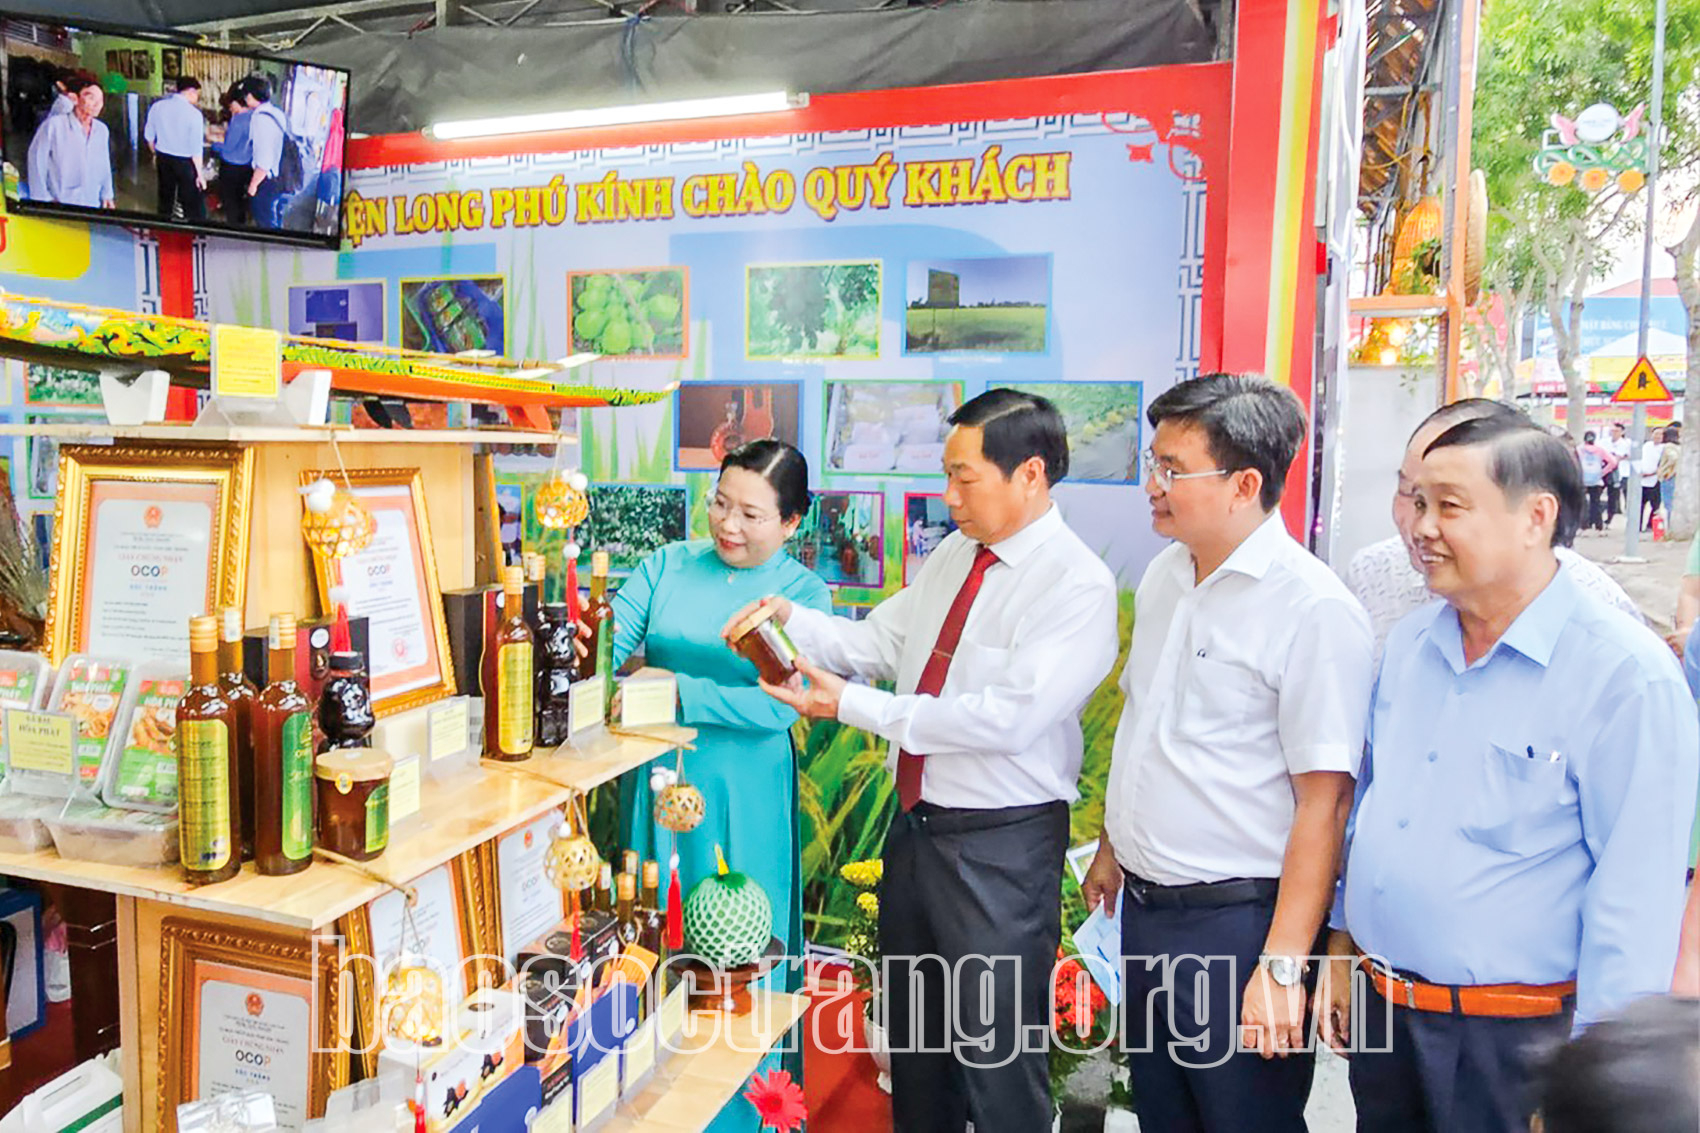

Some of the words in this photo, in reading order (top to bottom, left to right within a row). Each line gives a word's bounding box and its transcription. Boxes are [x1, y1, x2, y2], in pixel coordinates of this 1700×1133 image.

[342, 189, 388, 248] ỆN
[394, 189, 485, 236] LONG
[490, 173, 568, 229] PHÚ
[574, 171, 675, 225] KÍNH
[682, 160, 796, 218] CHÀO
[803, 151, 899, 222] QUÝ
[903, 145, 1072, 208] KHÁCH
[131, 565, 168, 577] OCOP
[235, 1049, 272, 1068] OCOP
